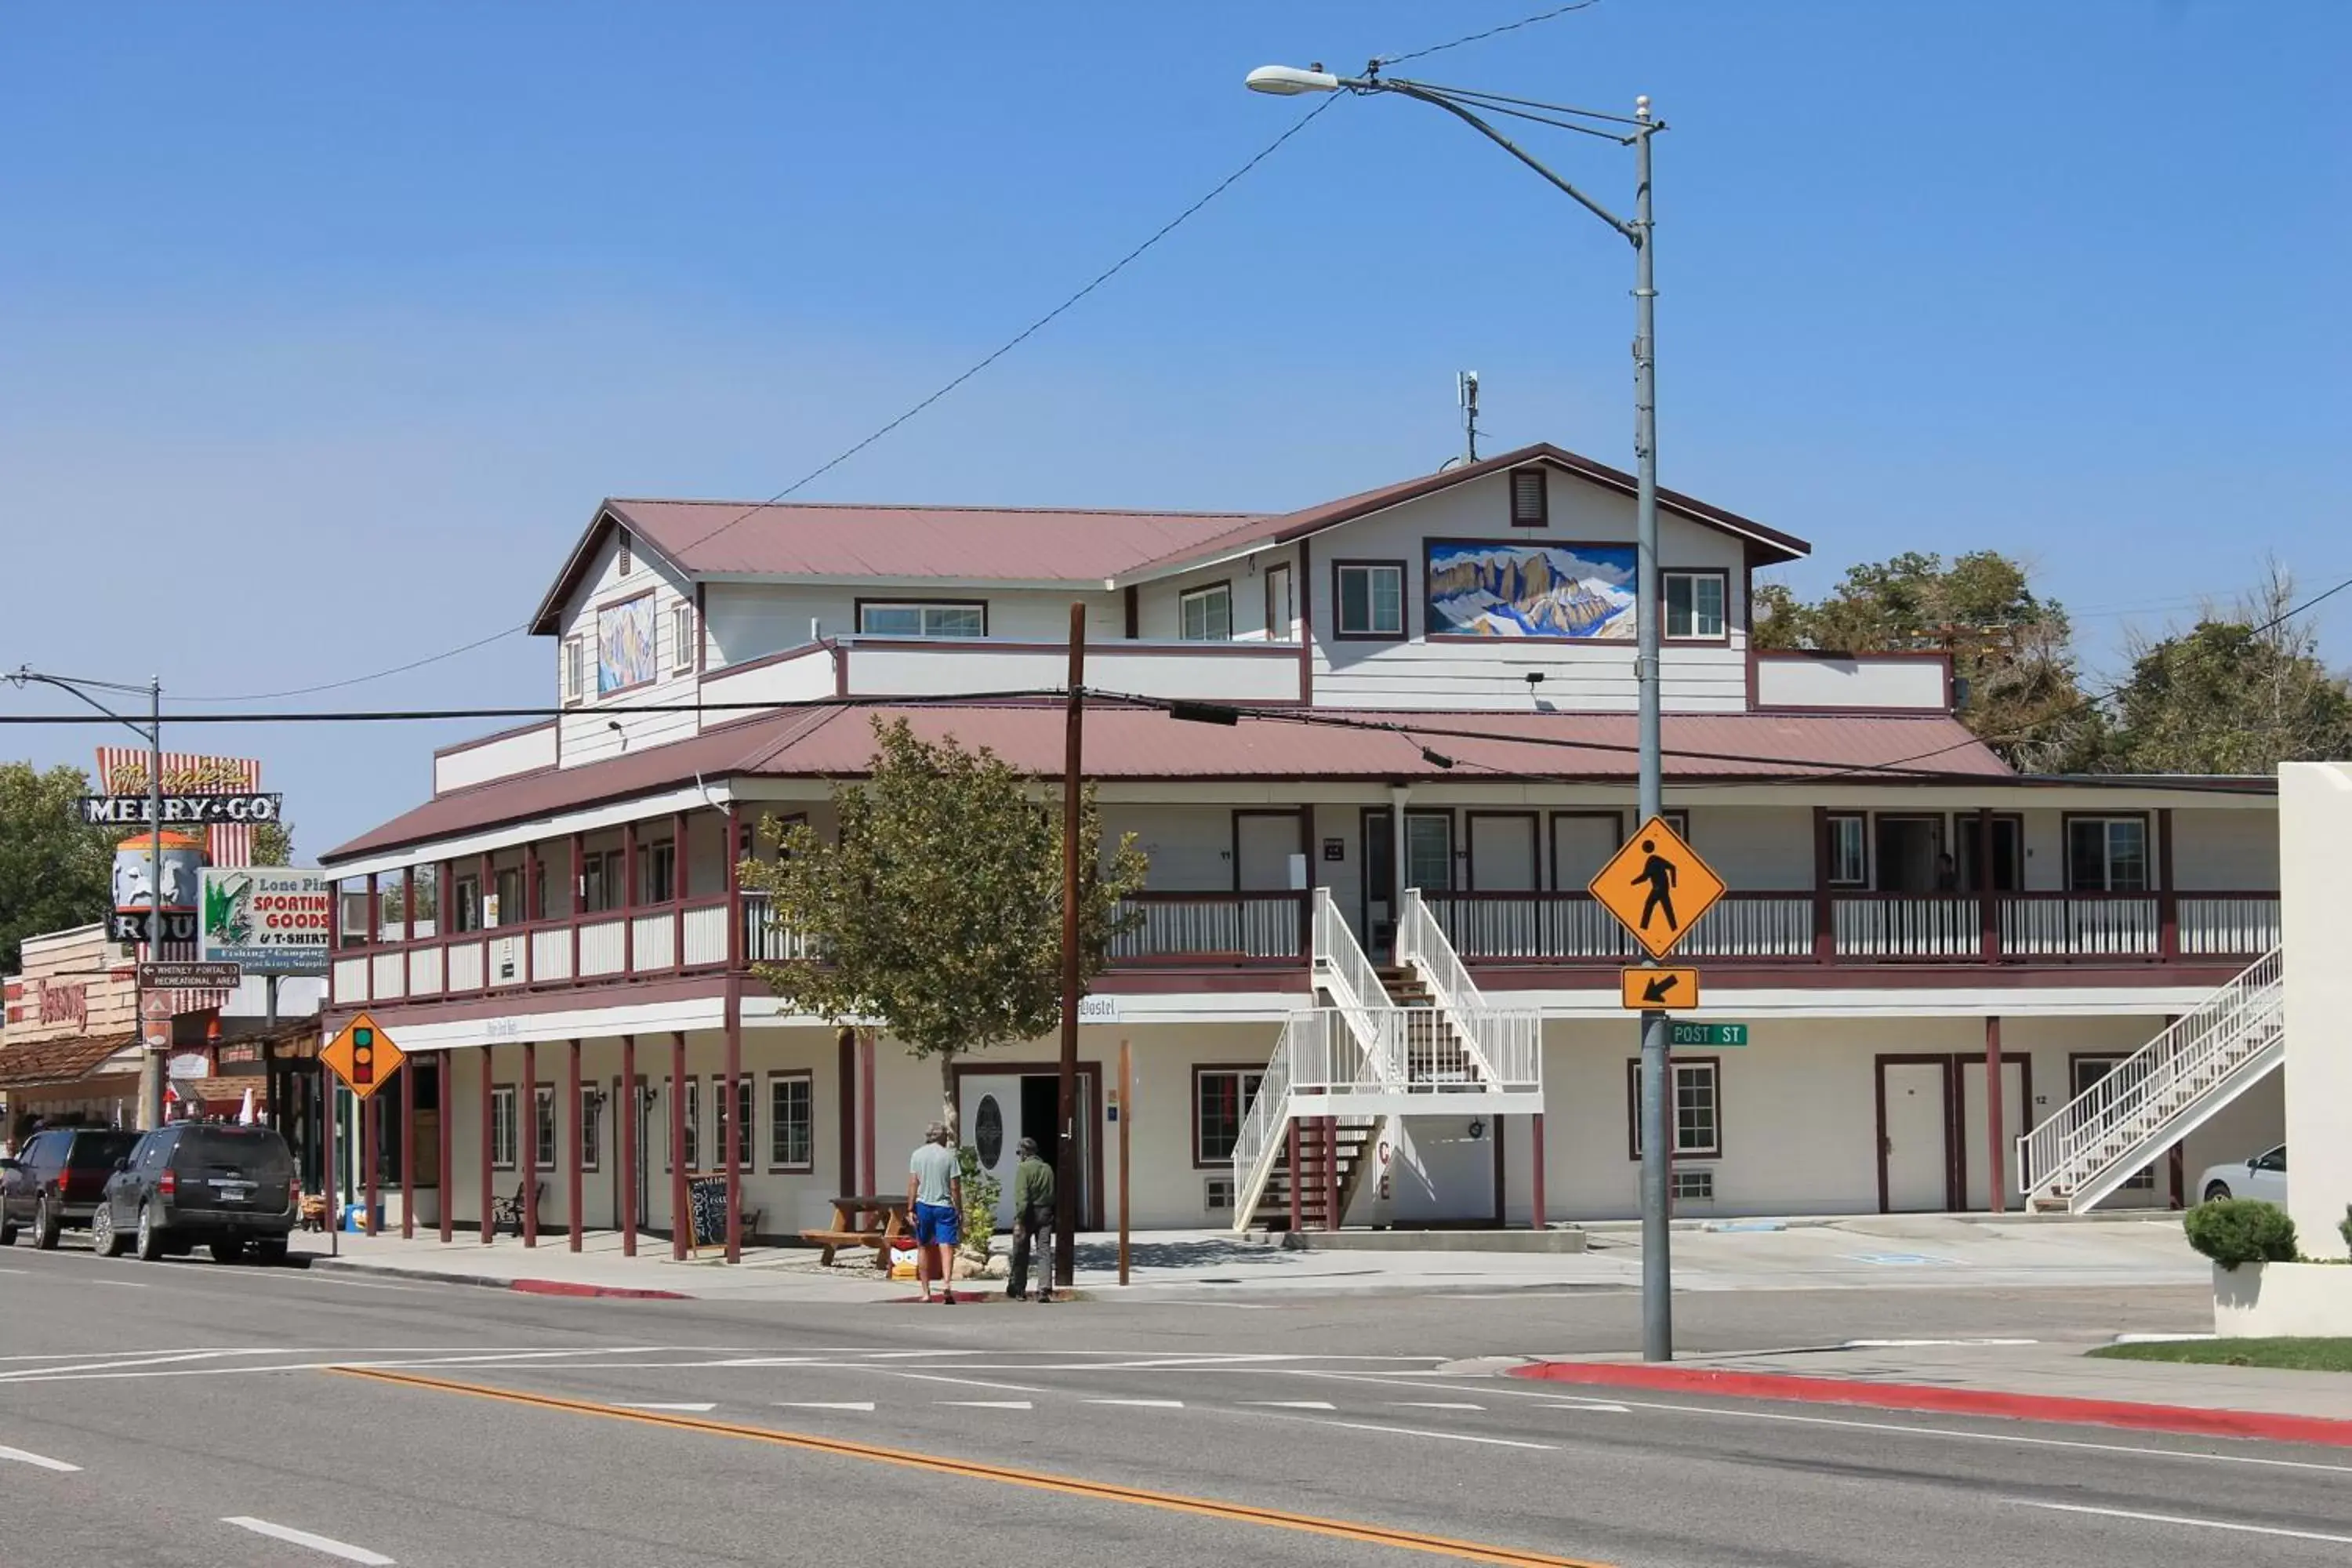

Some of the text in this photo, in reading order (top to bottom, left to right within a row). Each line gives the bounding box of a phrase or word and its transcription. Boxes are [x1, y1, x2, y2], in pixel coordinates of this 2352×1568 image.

[259, 878, 297, 891] Lone
[253, 896, 329, 911] SPORTIN
[265, 913, 329, 929] GOODS
[157, 965, 192, 975] WHITNEY
[195, 965, 226, 975] PORTAL
[154, 977, 238, 985] RECREATIONAL AREA
[1675, 1026, 1741, 1043] POST ST
